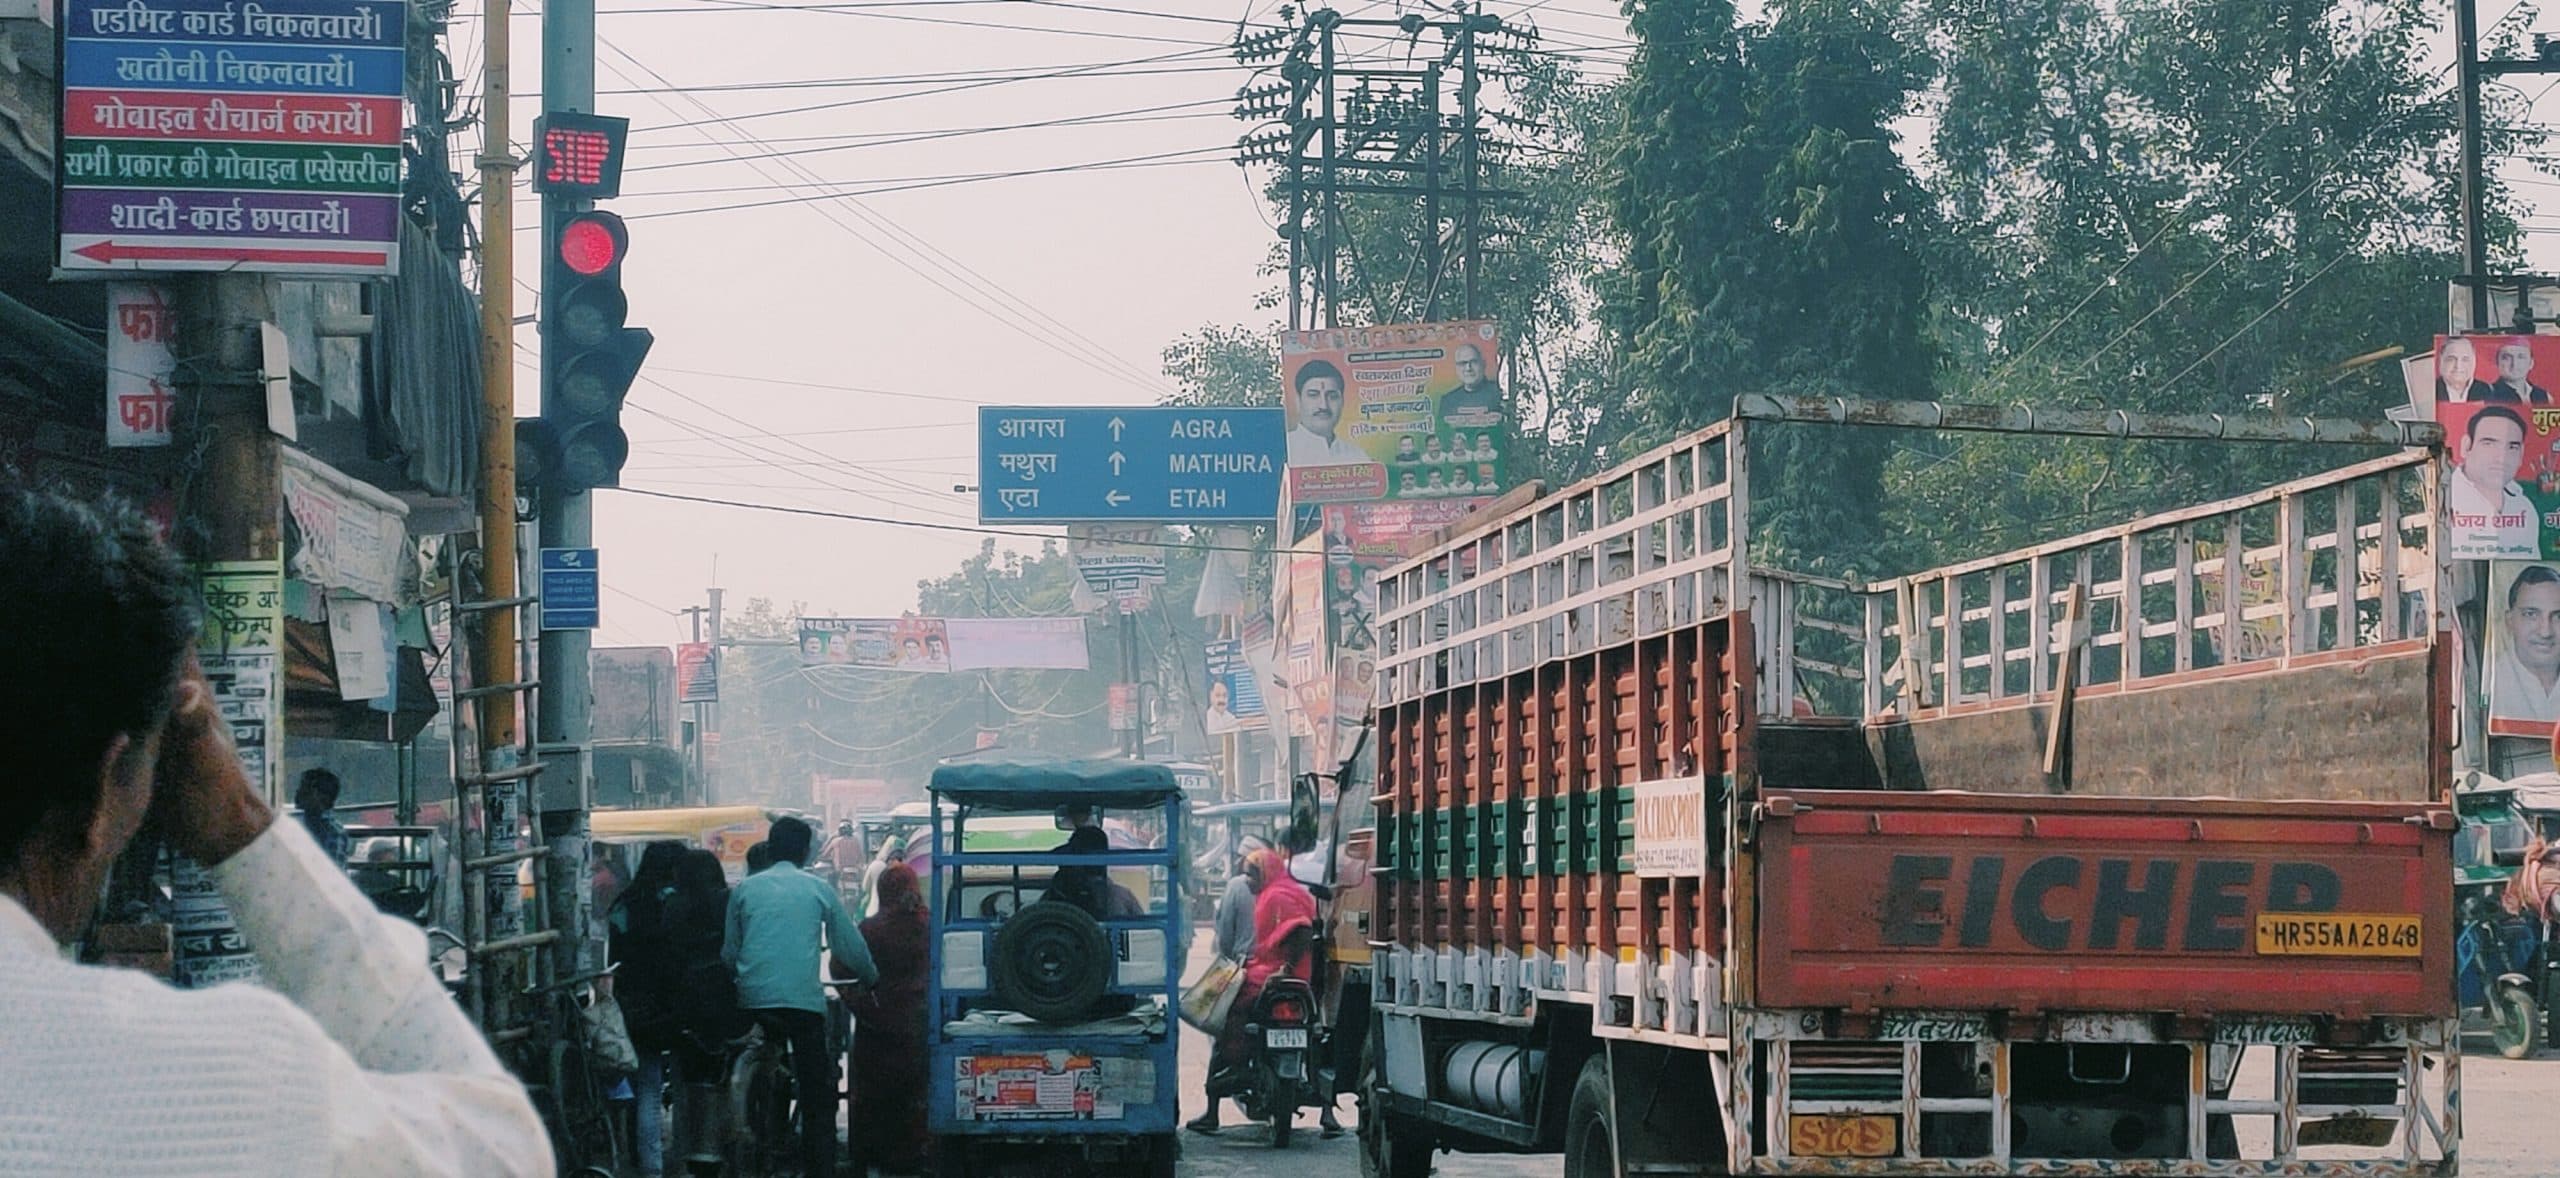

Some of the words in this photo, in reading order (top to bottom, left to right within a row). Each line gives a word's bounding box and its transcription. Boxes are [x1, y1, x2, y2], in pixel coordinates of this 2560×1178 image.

[91, 0, 175, 33] एडमिट
[182, 2, 236, 36] कार्ड
[116, 48, 208, 83] खतौनी
[204, 97, 285, 133] रीचार्ज
[64, 144, 112, 178] सभी
[118, 153, 174, 179] प्रकार
[179, 146, 209, 179] की
[303, 150, 398, 185] एसेसरीज
[998, 418, 1066, 439] आगरा
[1170, 419, 1233, 439] AGRA
[2532, 408, 2560, 436] मुल
[998, 453, 1057, 481] मथुरा
[1169, 453, 1273, 473] MATHURA
[998, 488, 1040, 512] एटा
[1169, 488, 1227, 509] ETAH
[2492, 510, 2527, 528] शर्मा
[2274, 921, 2419, 948] HR55AA2848
